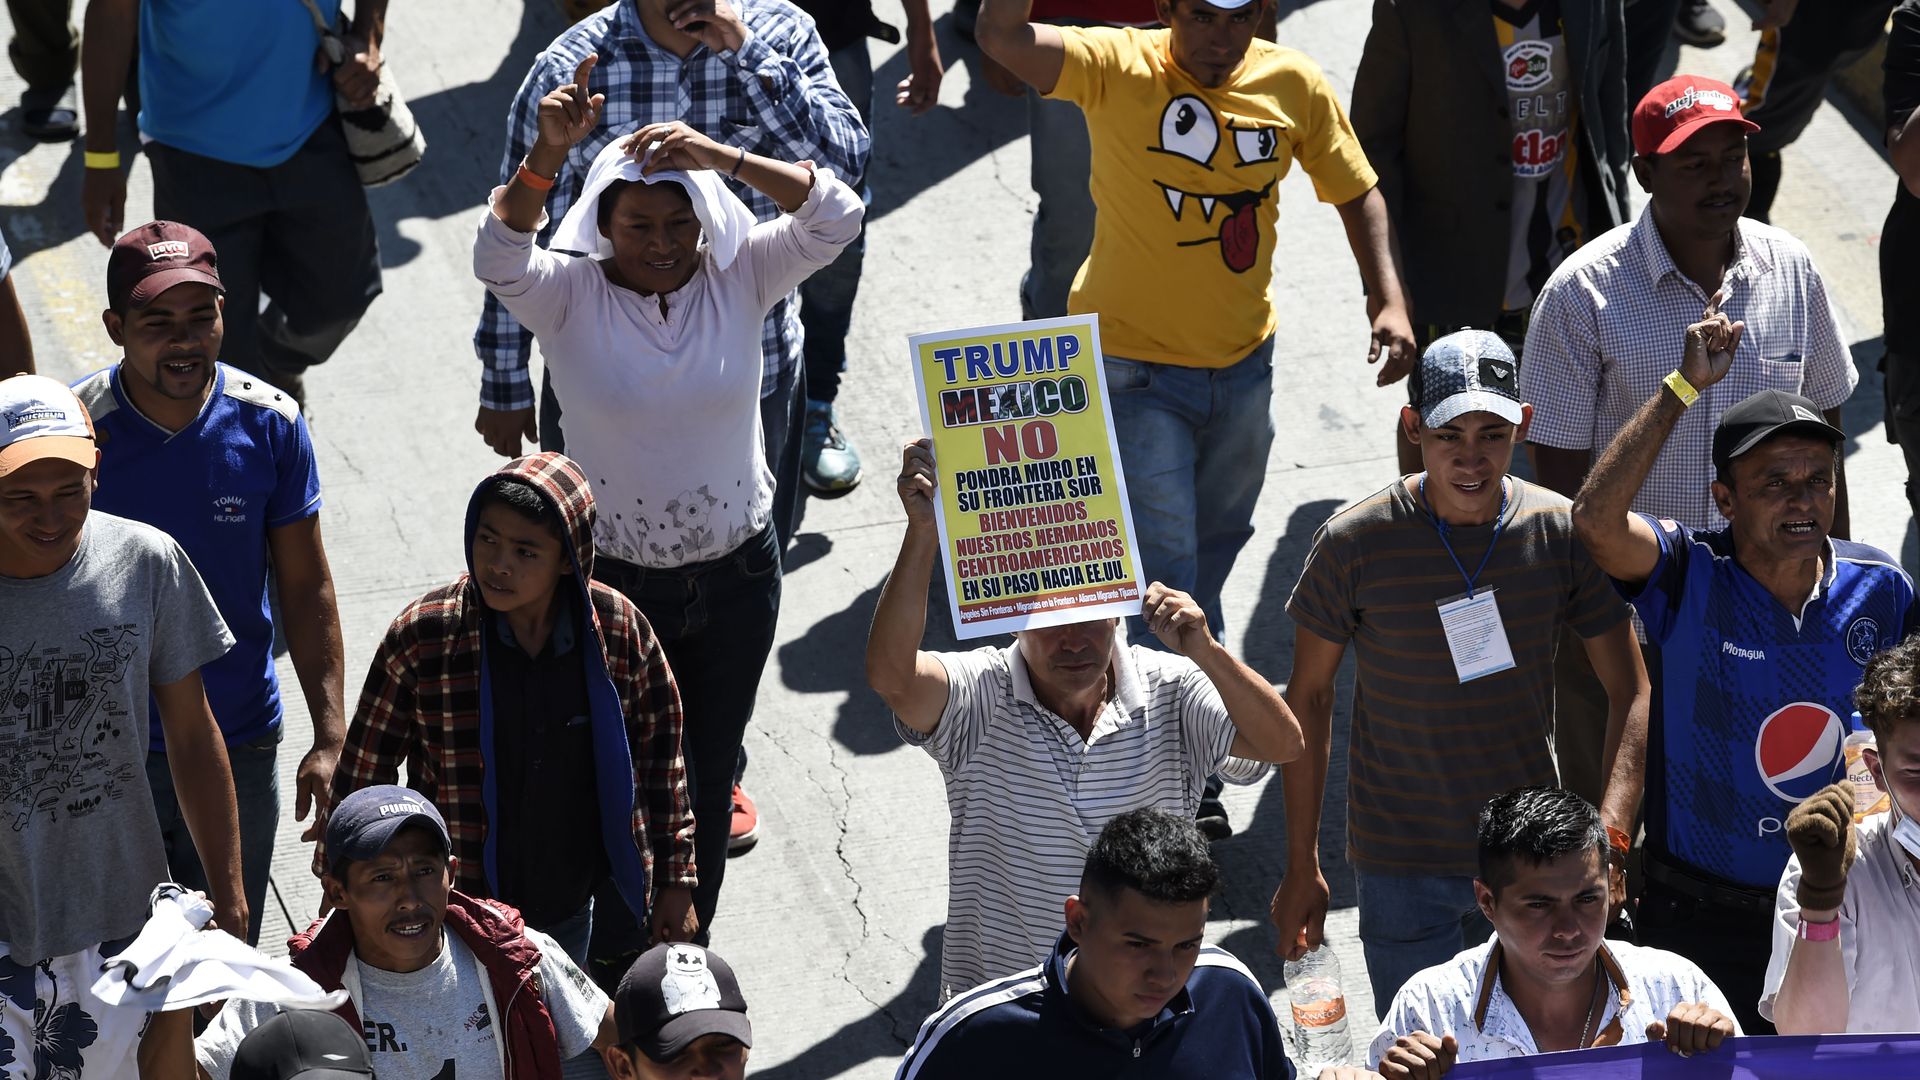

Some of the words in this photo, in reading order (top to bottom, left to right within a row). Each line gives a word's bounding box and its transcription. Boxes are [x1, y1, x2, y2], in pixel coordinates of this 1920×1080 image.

[934, 335, 1080, 382] TRUMP
[940, 376, 1088, 427] MEXICO
[982, 420, 1059, 466] NO
[955, 466, 1023, 492] PONDRA
[1024, 459, 1073, 483] MURO
[1075, 456, 1098, 476] EN
[212, 496, 247, 508] TOMMY
[957, 492, 981, 512] SU
[983, 481, 1066, 509] FRONTERA
[1067, 476, 1103, 498] SUR
[213, 514, 246, 523] HILFIGER
[978, 501, 1088, 533] BIENVENIDOS
[955, 533, 1033, 557] NUESTROS
[1035, 519, 1119, 547] HERMANOS
[957, 538, 1125, 579] CENTROAMERICANOS
[962, 580, 980, 601] EN
[982, 577, 1001, 597] SU
[1003, 572, 1040, 595] PASO
[1041, 566, 1085, 590] HACIA
[1086, 560, 1128, 583] EE.UU.
[980, 607, 989, 617] Sin
[988, 604, 1014, 615] Fronteras
[1041, 600, 1049, 608] en
[1049, 598, 1054, 607] la
[1054, 596, 1076, 606] Frontera
[1097, 589, 1120, 602] Migrante
[1119, 588, 1138, 598] Tijuana
[1722, 641, 1766, 661] MOTAGUA
